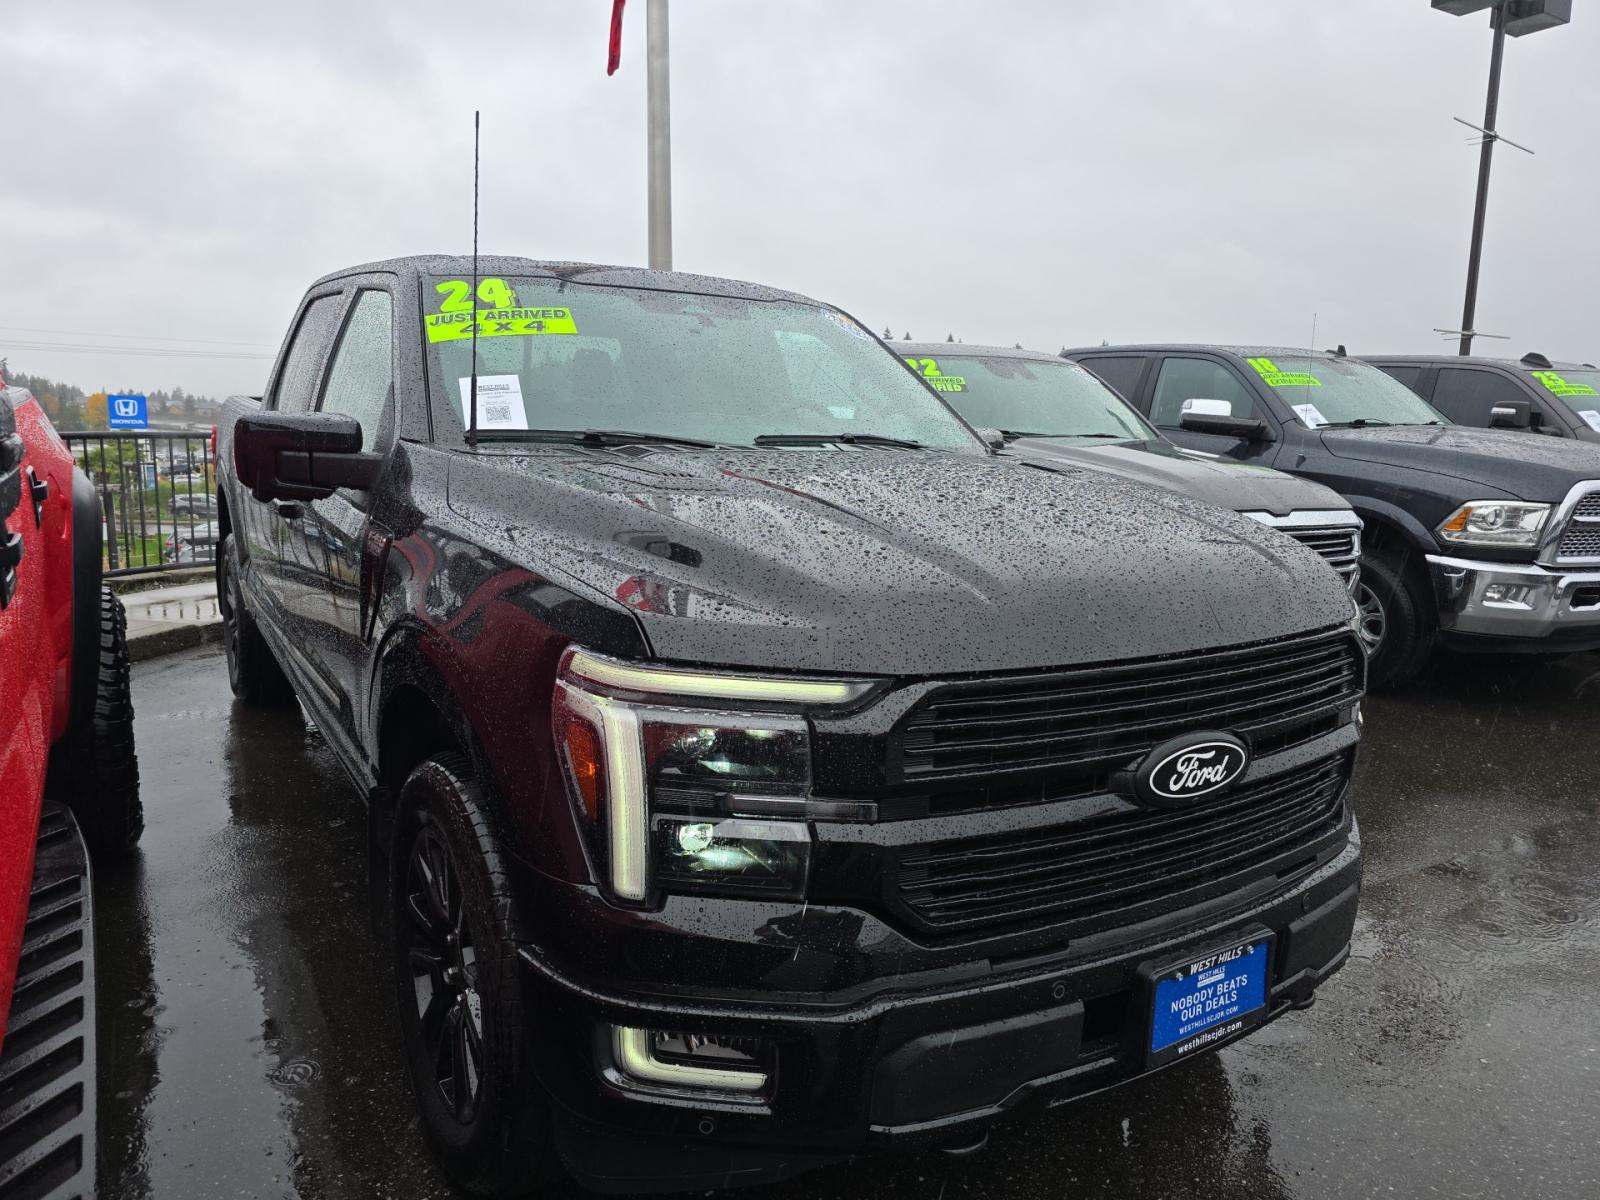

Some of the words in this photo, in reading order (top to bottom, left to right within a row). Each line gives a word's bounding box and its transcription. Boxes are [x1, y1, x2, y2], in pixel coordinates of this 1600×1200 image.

[436, 278, 515, 312] 24
[430, 313, 477, 327] JUST
[484, 309, 567, 321] ARRIVED
[460, 323, 482, 335] 4
[524, 320, 545, 332] 4
[1169, 750, 1229, 791] Ford
[1190, 955, 1217, 975] WEST
[1218, 945, 1244, 964] HILLS
[1198, 970, 1211, 981] WEST
[1211, 966, 1226, 977] HILLS
[1171, 987, 1214, 1013] NOBODY
[1217, 974, 1248, 995] BEATS
[1181, 1004, 1203, 1021] OUR
[1206, 991, 1238, 1012] DEALS
[1179, 1005, 1239, 1035] WESTHILLSCJDR.COM
[1178, 1020, 1242, 1054] westhillscjdr.com
